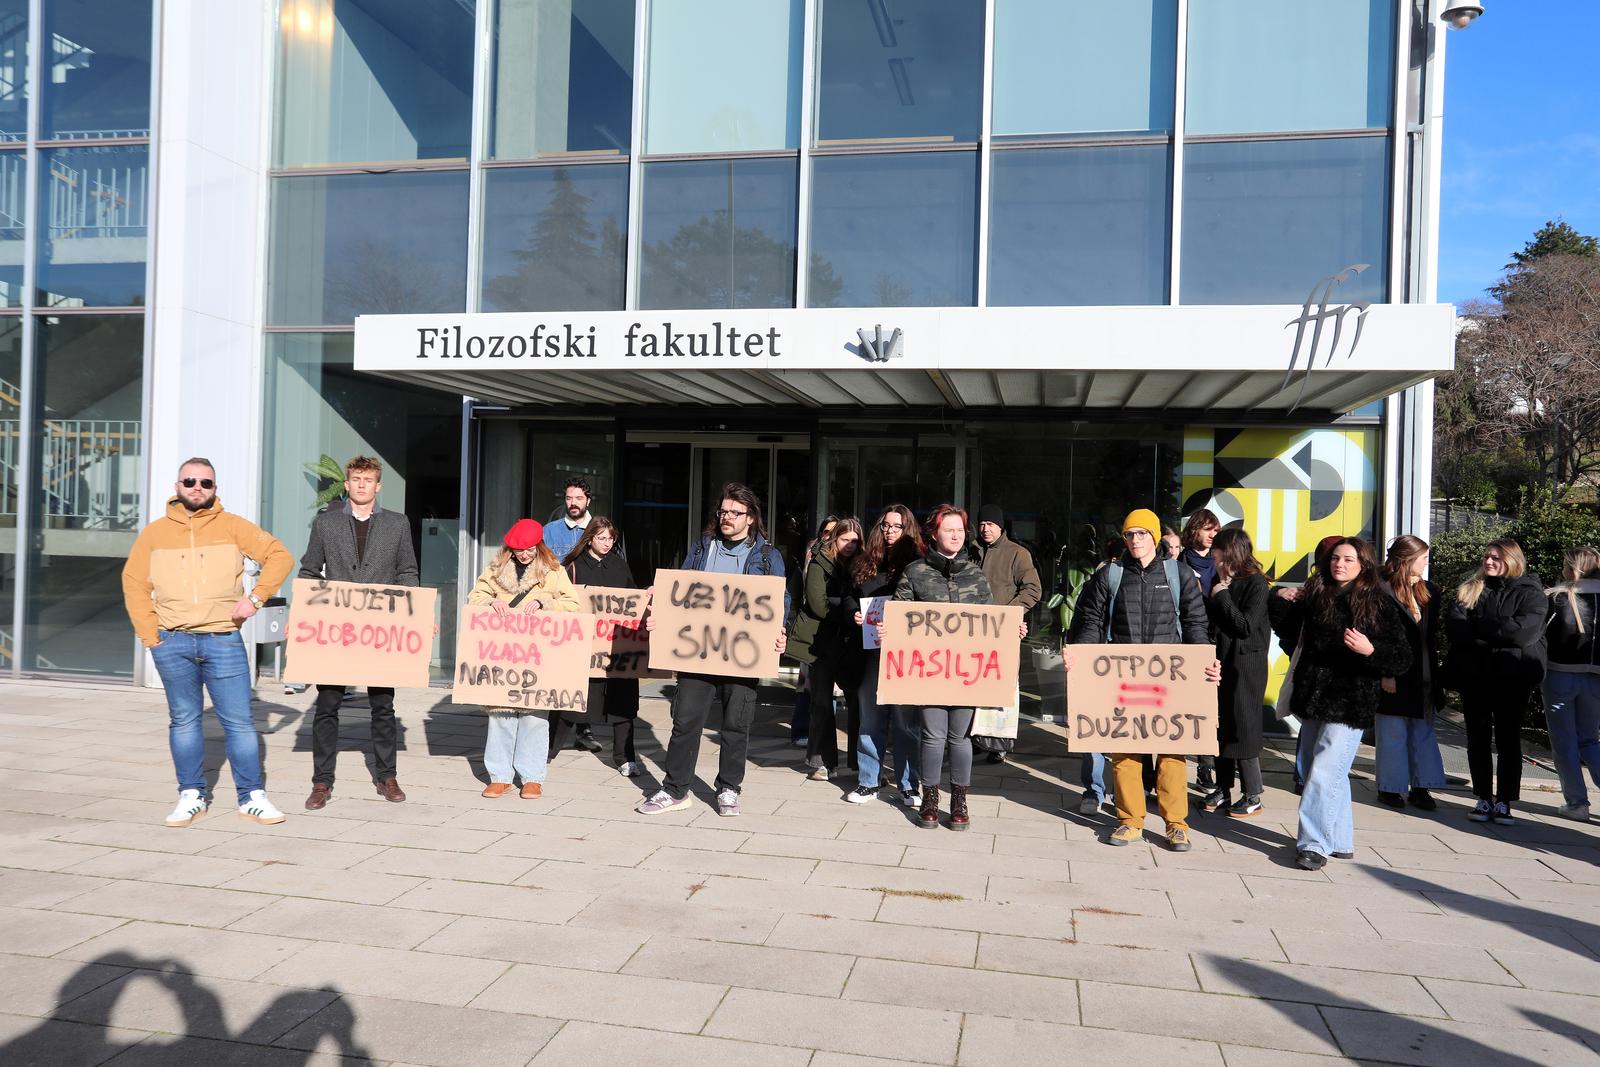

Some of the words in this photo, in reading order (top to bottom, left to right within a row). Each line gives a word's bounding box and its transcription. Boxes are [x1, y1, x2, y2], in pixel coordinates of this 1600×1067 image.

[416, 323, 597, 359] Filozofski
[624, 322, 782, 358] fakultet
[589, 594, 641, 618] NIJE
[722, 584, 775, 622] VAS
[295, 620, 423, 655] SLOBODNO
[470, 611, 584, 647] KORUPCIJA
[904, 609, 1006, 639] PROTIV
[478, 640, 541, 665] VLADA
[672, 624, 761, 669] SMO
[458, 661, 538, 688] NAROD
[885, 649, 1002, 687] NASILJA
[1093, 654, 1188, 682] OTPOR
[508, 688, 587, 711] STRADA
[1076, 706, 1207, 741] DUŽNOST
